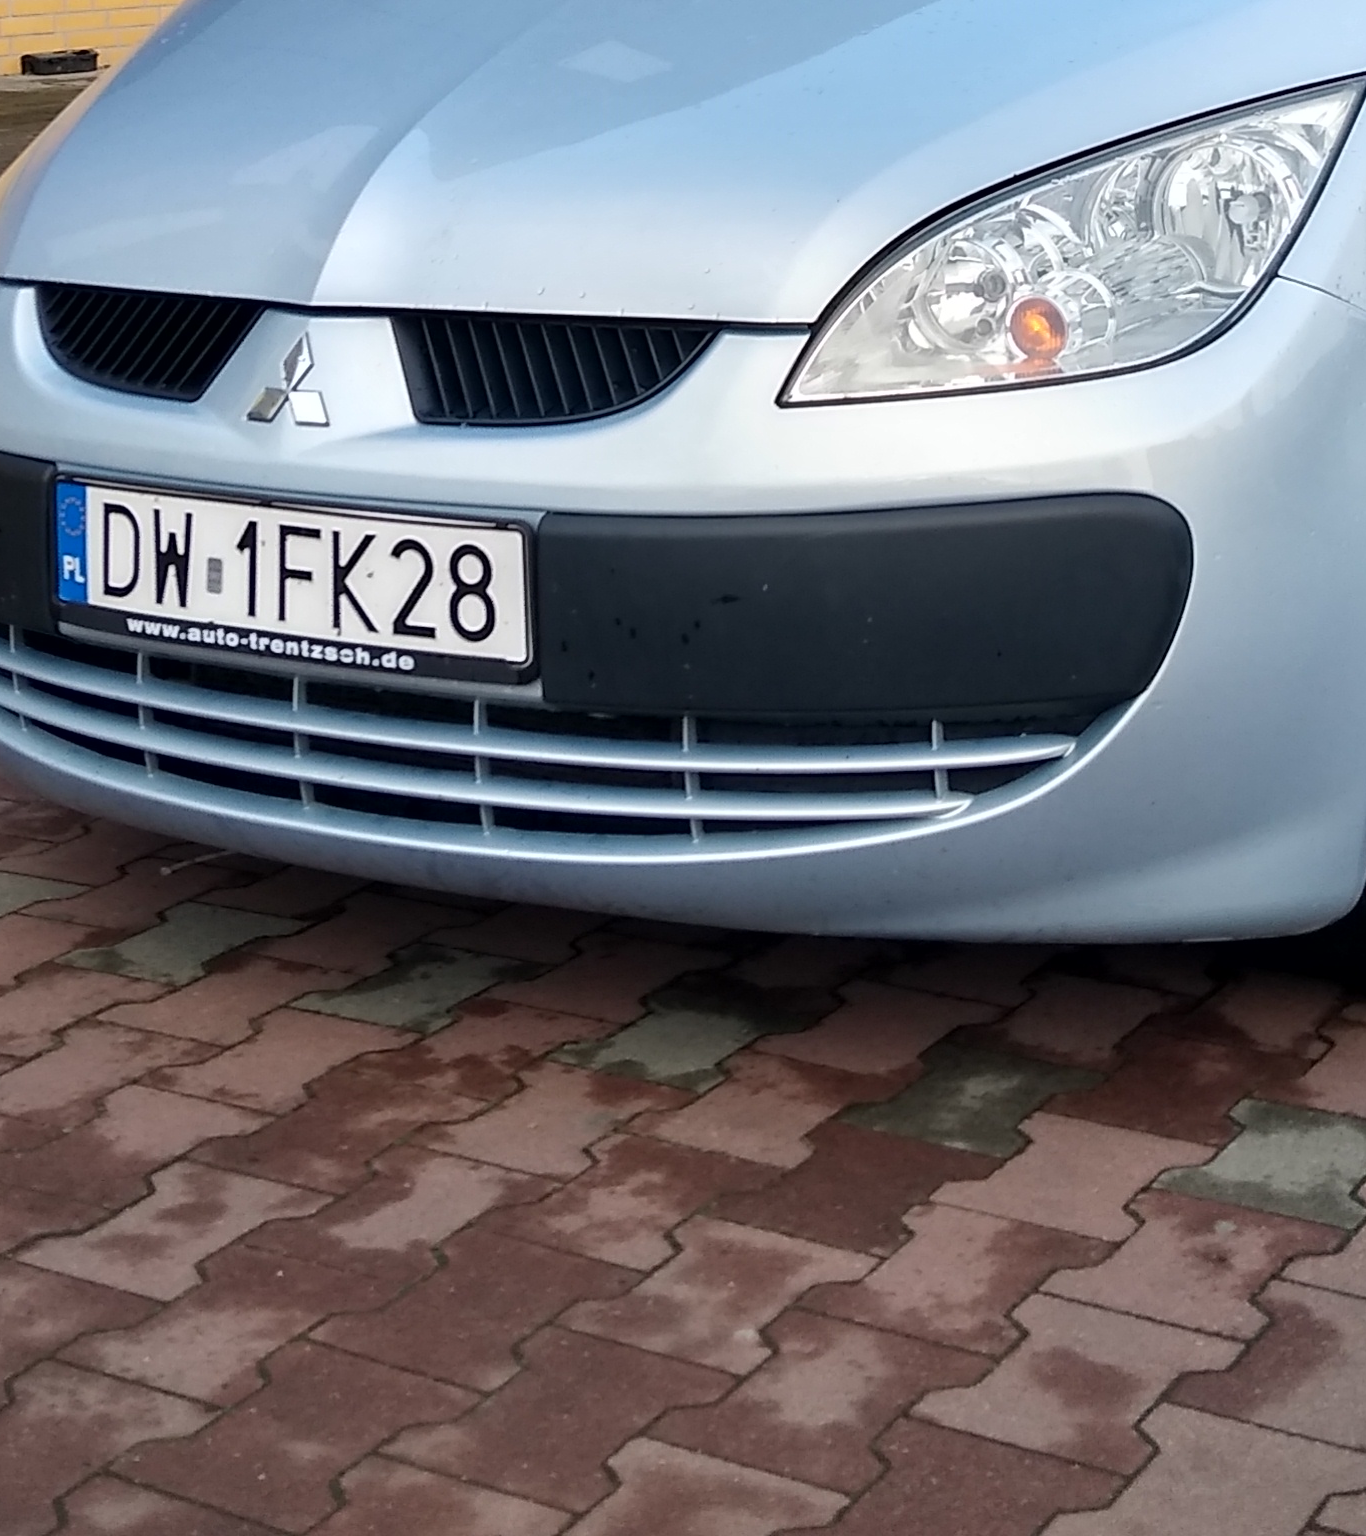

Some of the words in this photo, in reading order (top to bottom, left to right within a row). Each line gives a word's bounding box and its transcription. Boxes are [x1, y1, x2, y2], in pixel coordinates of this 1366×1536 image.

[62, 554, 86, 583] PL
[102, 502, 193, 608] DW
[236, 519, 496, 643] 1FK28
